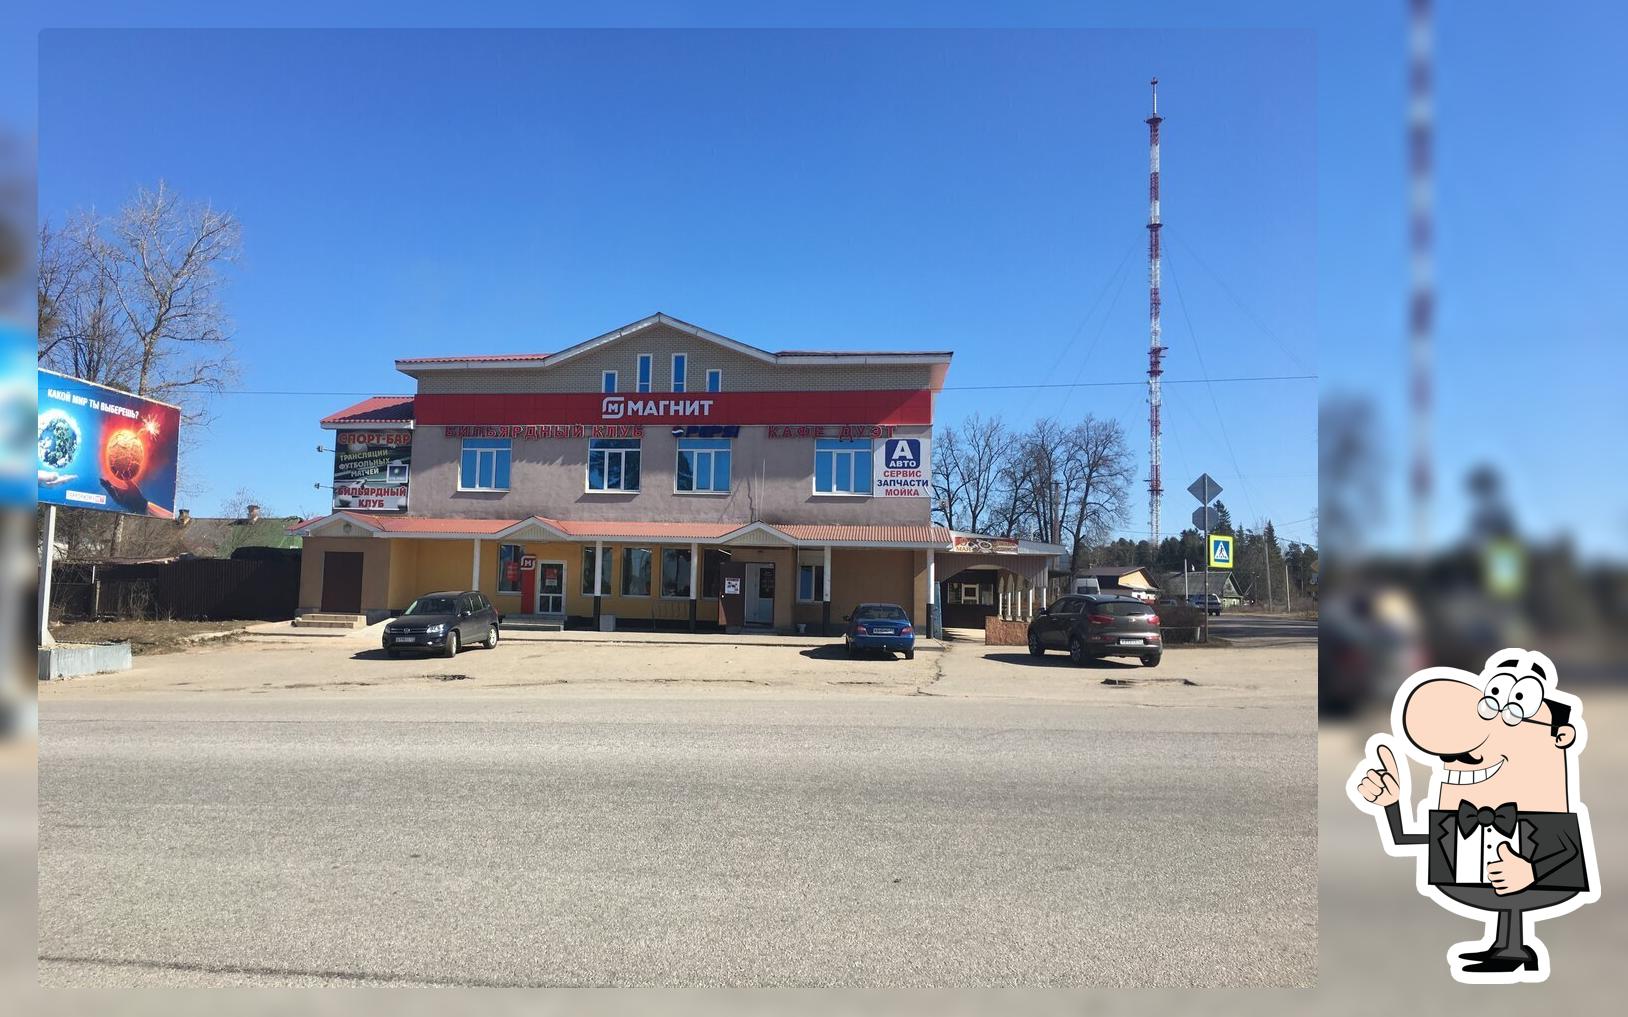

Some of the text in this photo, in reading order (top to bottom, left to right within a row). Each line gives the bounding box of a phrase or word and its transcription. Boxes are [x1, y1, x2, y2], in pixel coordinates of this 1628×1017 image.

[47, 389, 139, 419] КАКОЙ МИР ТЫ ВЫБЕРЕШЬ?
[627, 400, 714, 416] МАГНИТ
[339, 431, 411, 445] СПОРТ-БАР
[445, 425, 644, 440] БИЛЬЯРДНЫЙ КЛУБ
[768, 425, 897, 442] КАФЕ ДУЭТ
[340, 449, 388, 462] ТРАНСЛЯЦИИ
[339, 457, 391, 470] ФУТБОЛЬНЫХ
[889, 460, 917, 468] АВТО
[351, 467, 380, 478] МАТЧЕЙ
[883, 470, 922, 478] СЕРВИС
[877, 479, 929, 487] ЗАПЧАСТИ
[336, 485, 407, 497] БИЛЬЯРДНЫЙ
[885, 487, 919, 497] МОЙКА
[358, 499, 385, 508] КЛУБ
